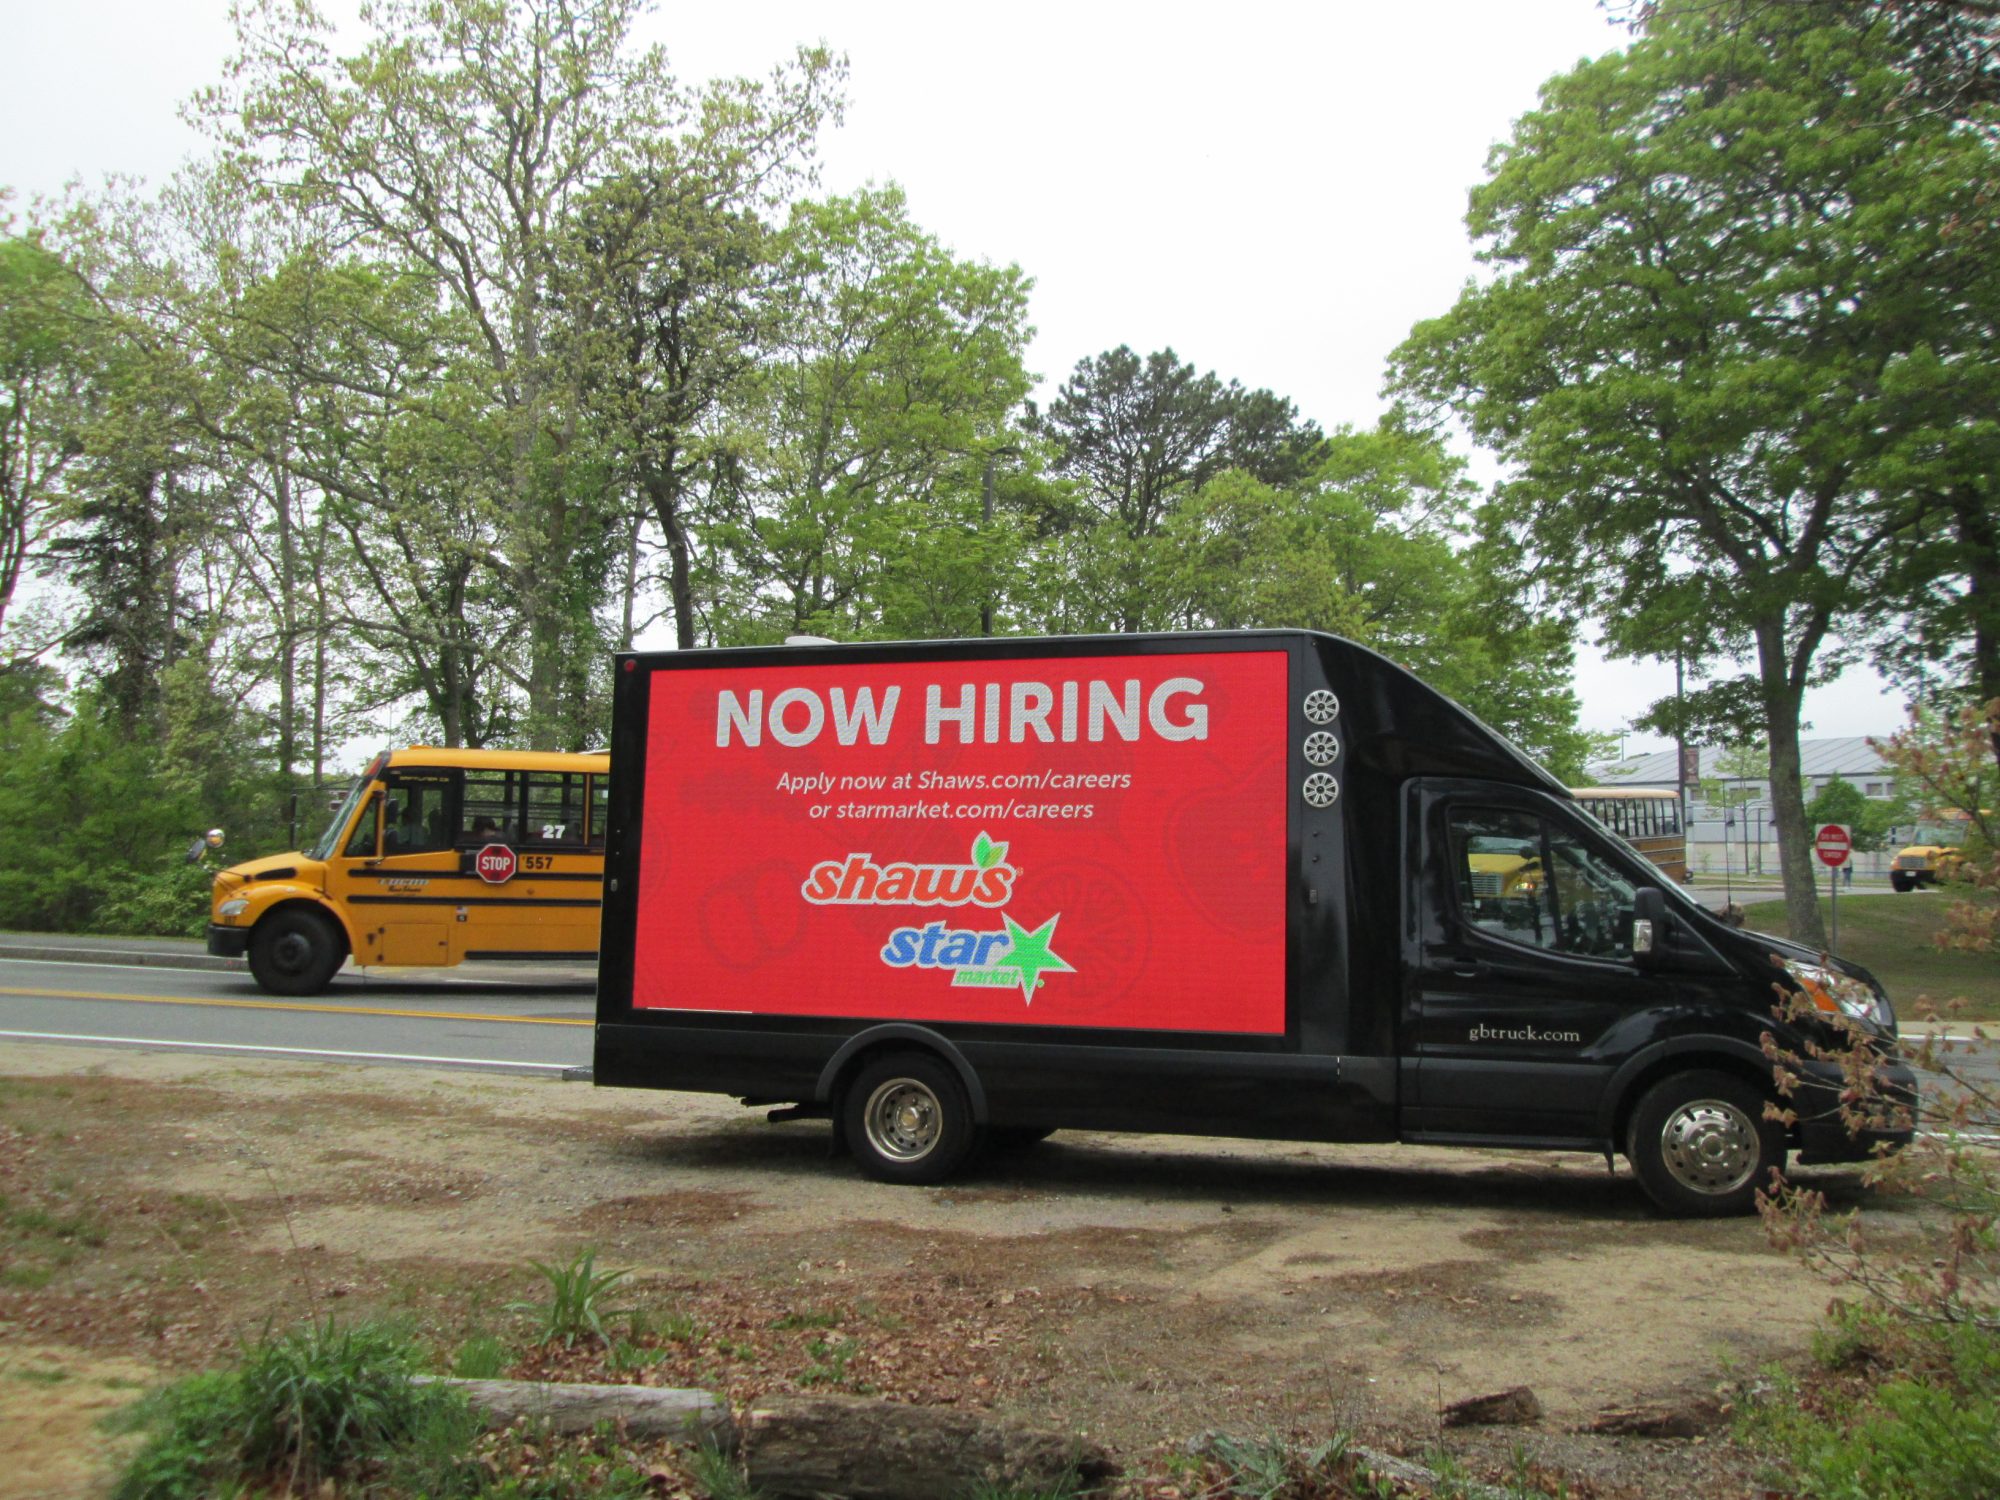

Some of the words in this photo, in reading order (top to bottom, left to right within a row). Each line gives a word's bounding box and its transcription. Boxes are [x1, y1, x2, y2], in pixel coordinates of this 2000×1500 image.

[716, 685, 901, 747] NOW
[924, 677, 1209, 745] HIRING
[776, 771, 836, 795] Apply
[840, 776, 887, 790] now
[891, 772, 913, 789] at
[917, 768, 1132, 790] Shaws.com/careers
[809, 804, 832, 819] or
[836, 798, 1095, 819] starmarket.com/careers
[542, 824, 566, 839] 27
[481, 856, 511, 871] STOP
[525, 856, 554, 870] 557
[882, 922, 1010, 967] star
[956, 969, 1019, 985] market
[1469, 1023, 1581, 1041] gbtruck.com
